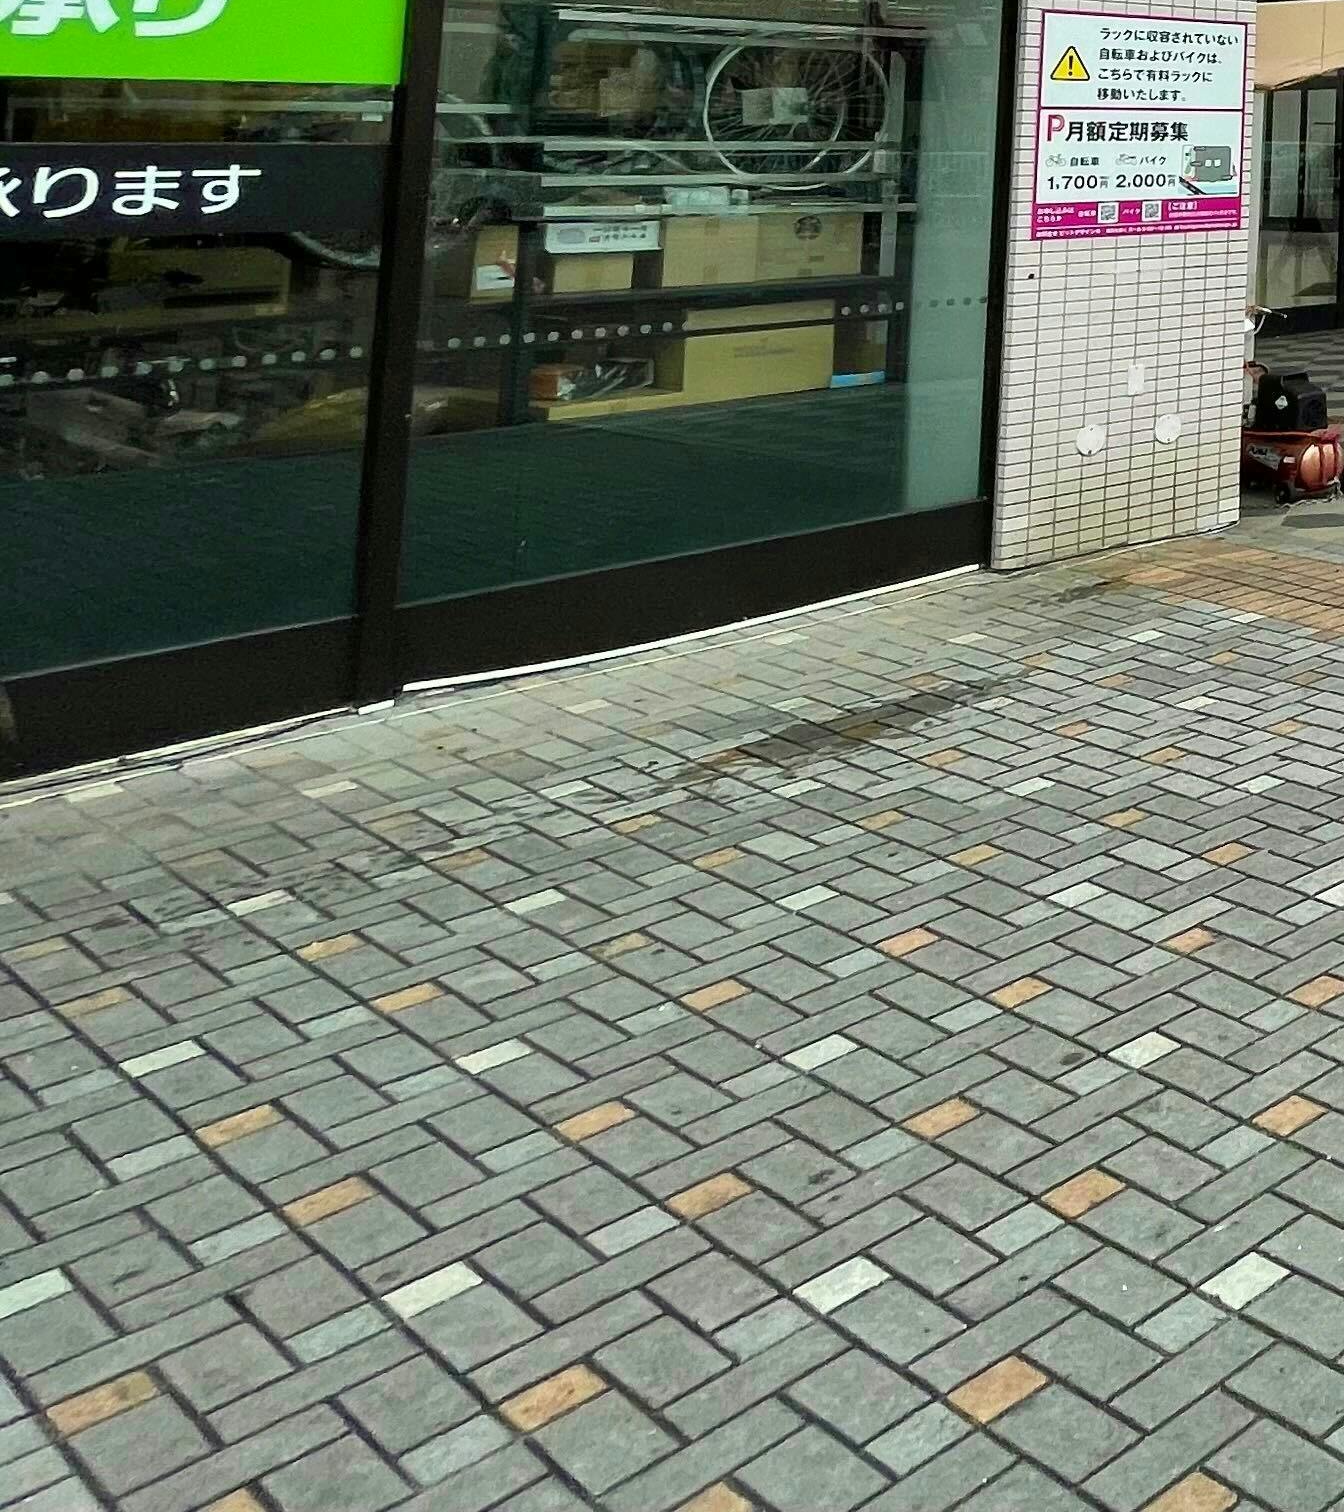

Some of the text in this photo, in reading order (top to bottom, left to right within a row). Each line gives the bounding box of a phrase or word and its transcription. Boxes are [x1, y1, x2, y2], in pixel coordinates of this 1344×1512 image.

[1100, 27, 1239, 46] ラックに収容されていない
[1098, 68, 1213, 83] こちらで有料ラックに
[1097, 88, 1186, 102] 移動いたします。
[1065, 121, 1189, 142] 月額定期募集
[1070, 155, 1167, 167] 自転車 バイク
